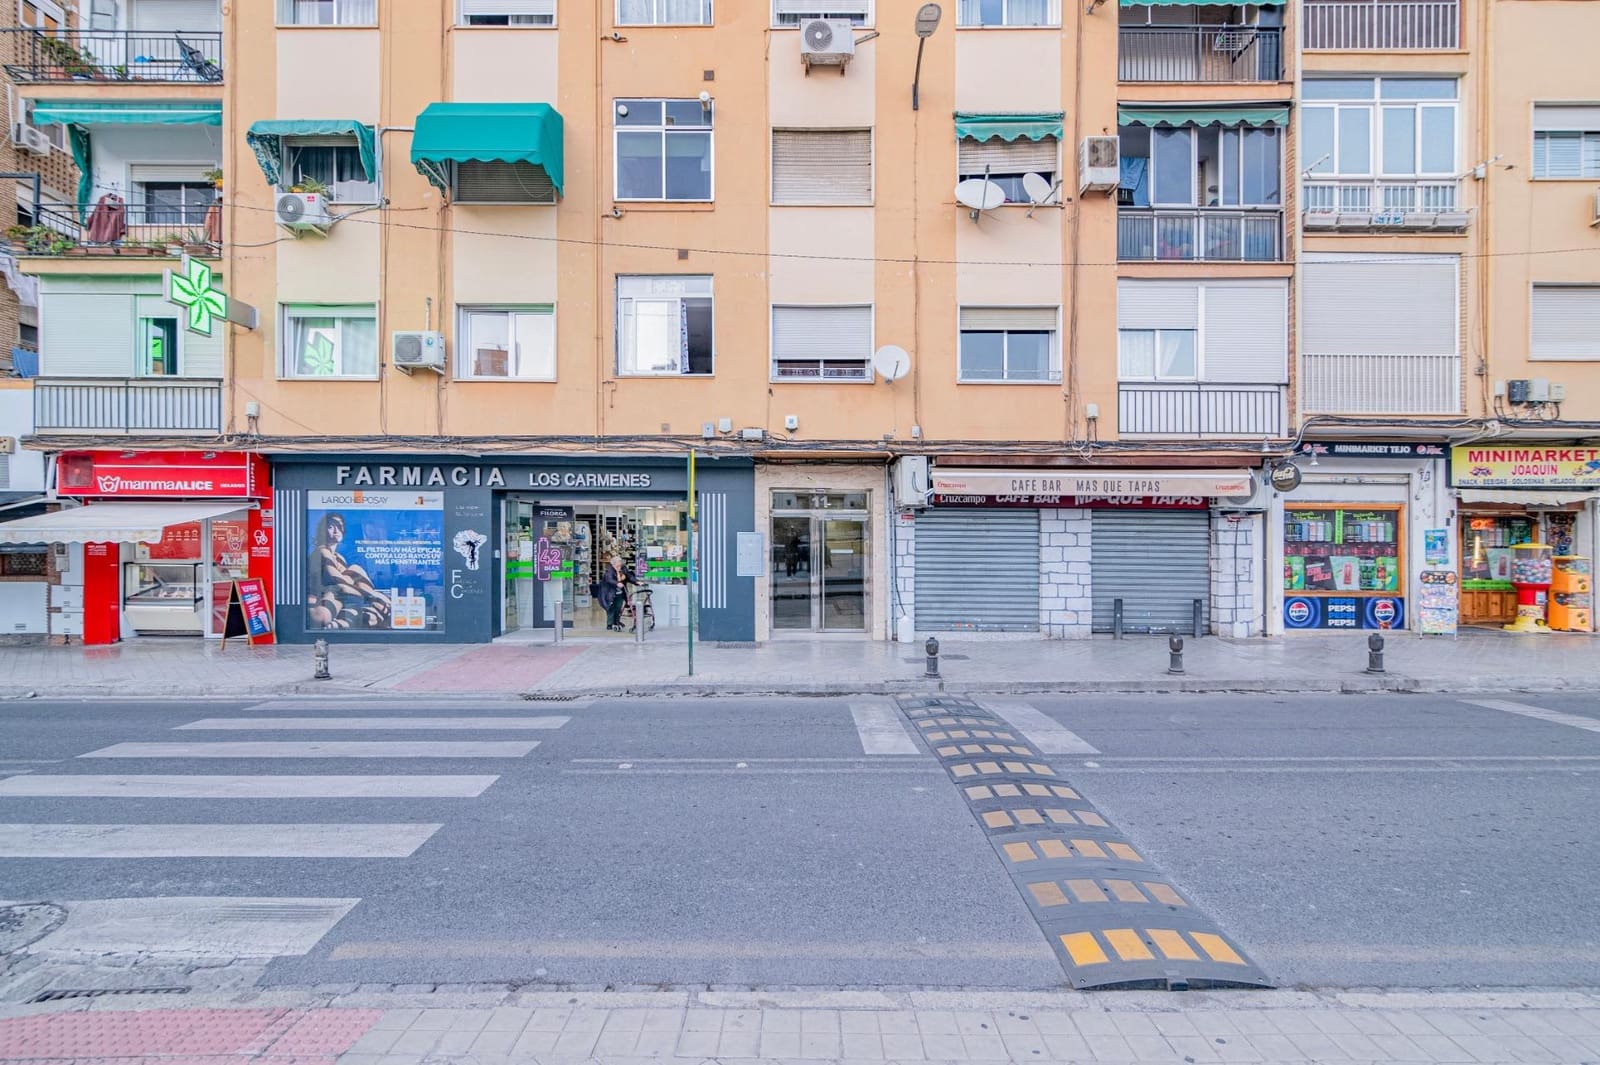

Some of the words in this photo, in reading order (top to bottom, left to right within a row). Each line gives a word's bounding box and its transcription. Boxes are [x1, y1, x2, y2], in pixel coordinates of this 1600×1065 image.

[1335, 444, 1388, 453] MINIMARKET
[1390, 445, 1411, 454] TEJO
[1468, 449, 1598, 462] MINIMARKET
[336, 466, 505, 486] FARMACIA
[529, 472, 560, 486] LOS
[564, 473, 651, 487] CARMENES
[1011, 480, 1037, 491] CAFE
[1042, 480, 1061, 491] BAR
[1076, 480, 1098, 492] MAS
[1103, 480, 1122, 492] QUE
[1129, 480, 1160, 492] TAPAS
[940, 494, 986, 505] Cruzcampo
[1033, 495, 1061, 504] BAR
[540, 548, 560, 565] 42
[452, 570, 462, 584] F
[450, 584, 464, 598] C
